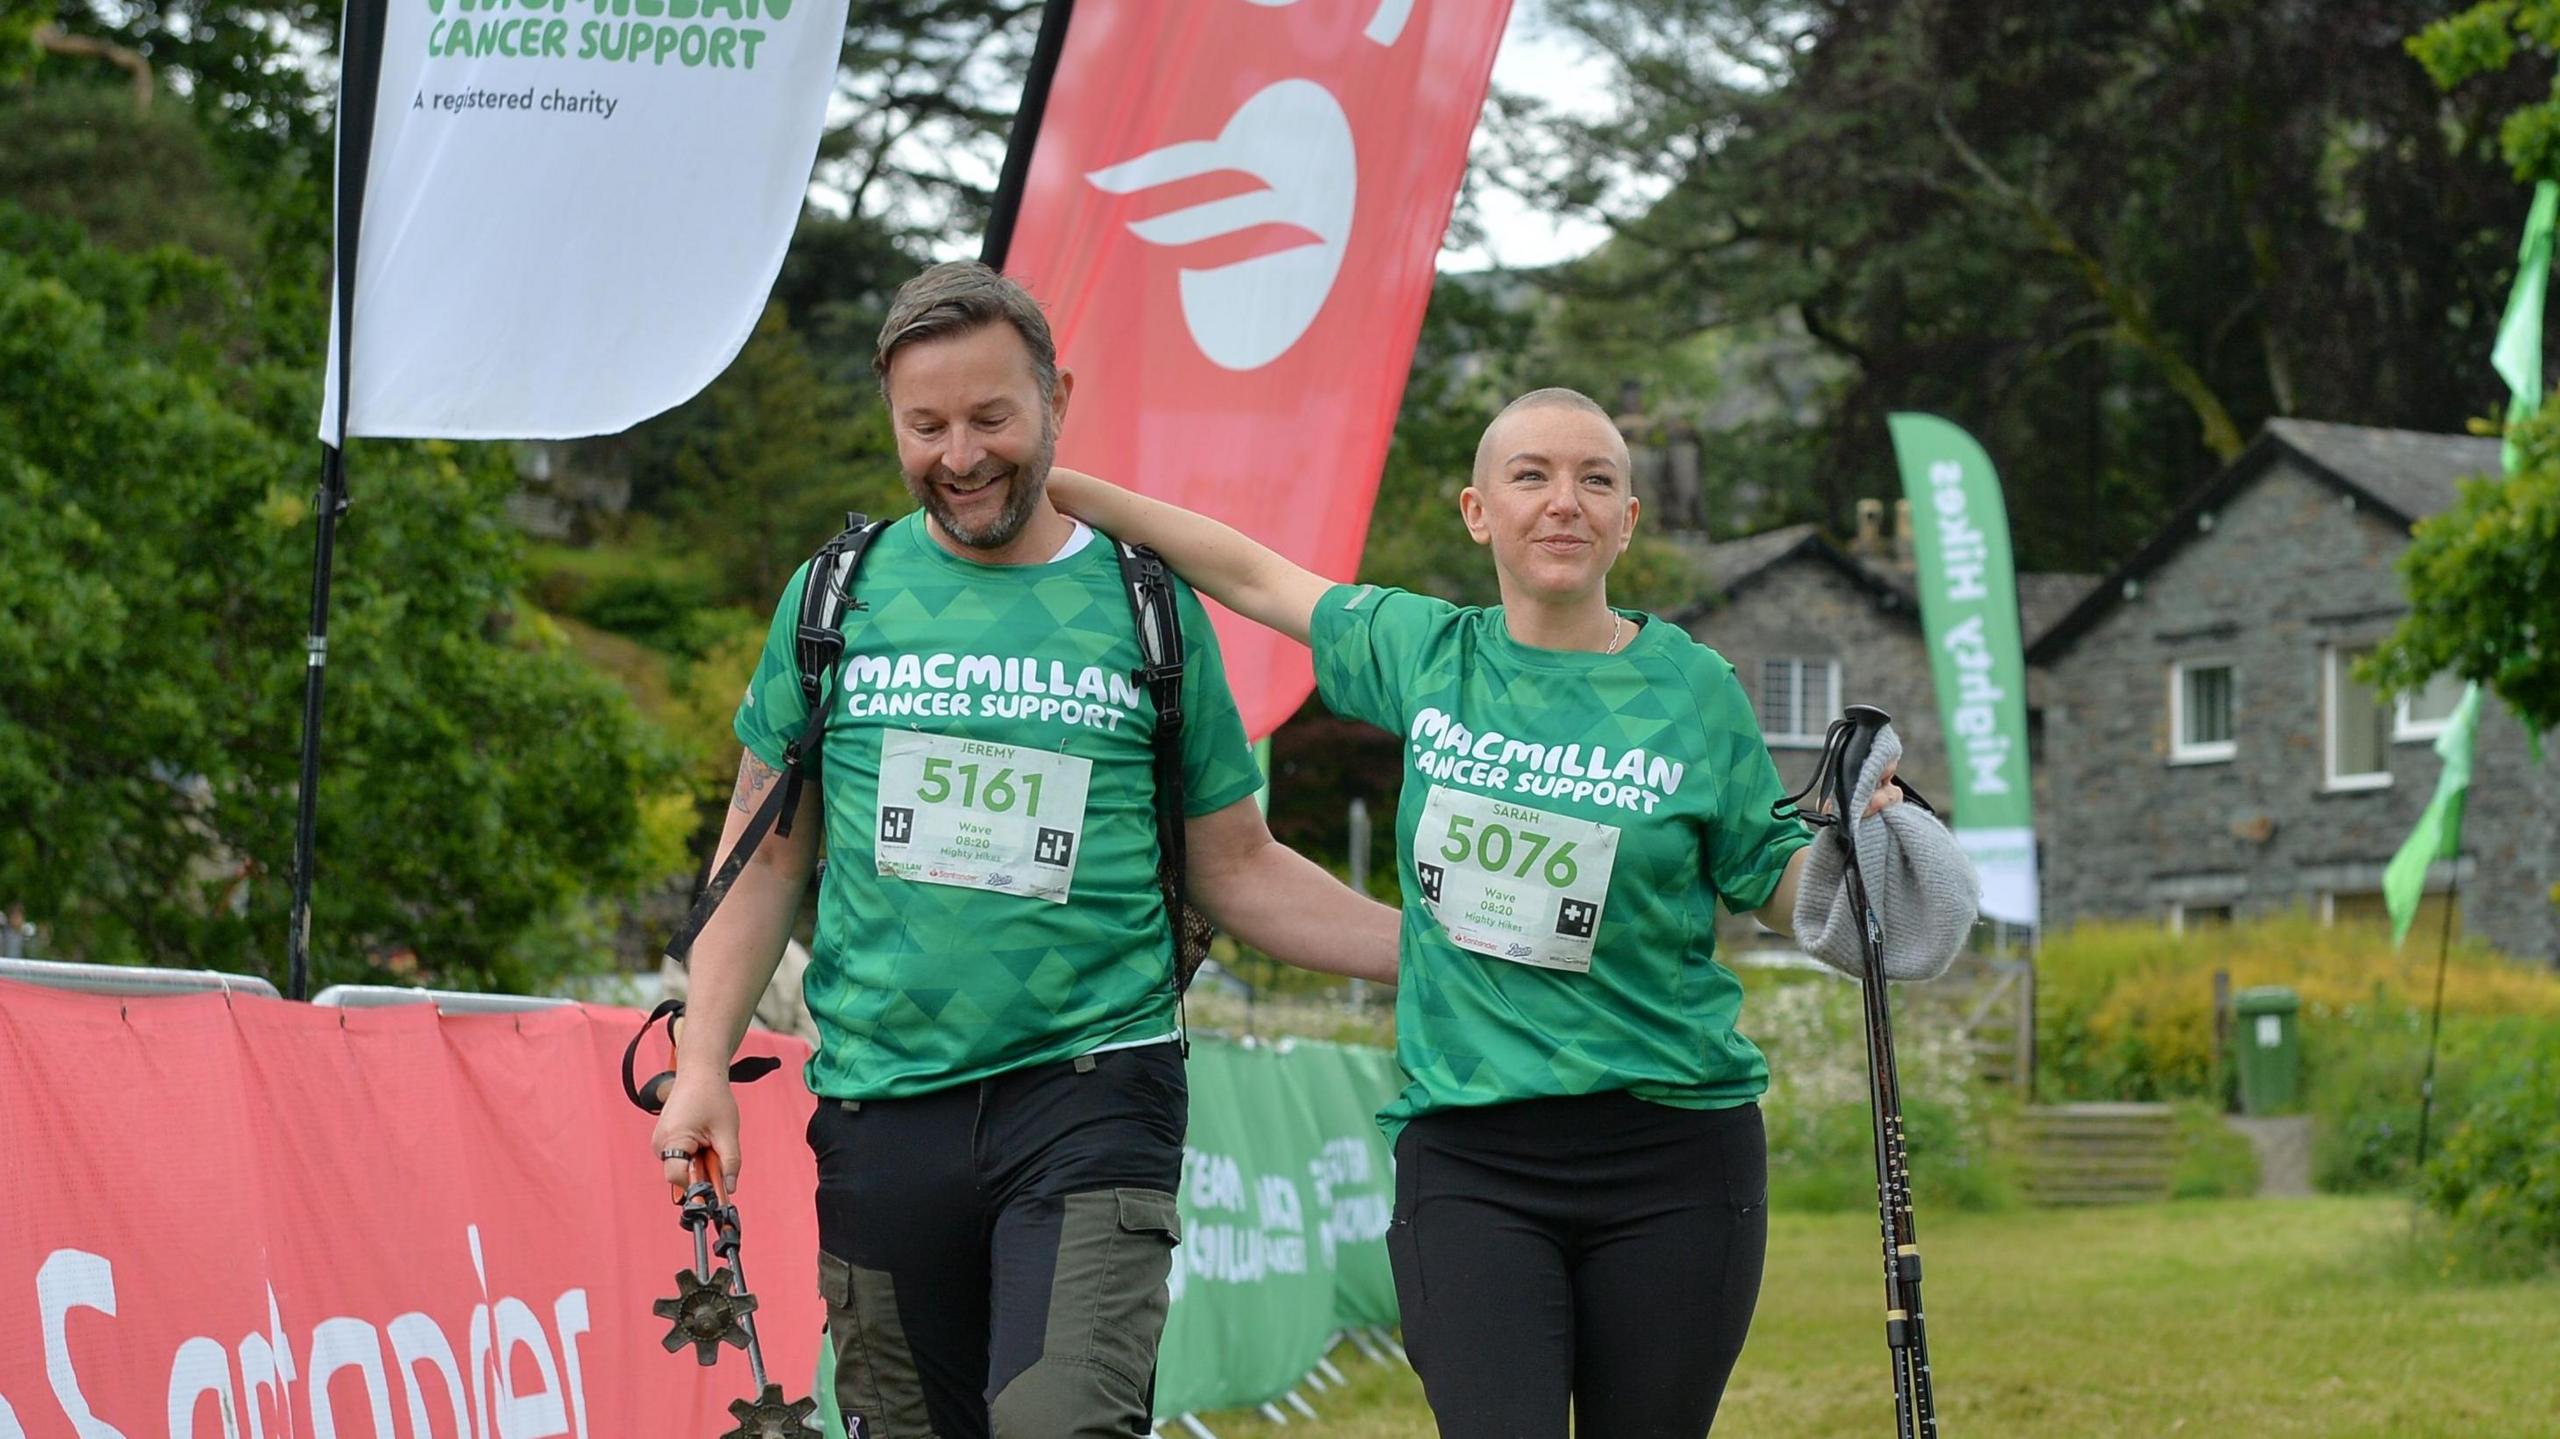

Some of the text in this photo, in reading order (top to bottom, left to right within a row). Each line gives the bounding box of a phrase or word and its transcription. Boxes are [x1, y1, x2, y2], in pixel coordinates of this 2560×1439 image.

[429, 18, 766, 69] CANCER SUPPORT
[413, 87, 618, 119] A registered charity
[844, 653, 1140, 710] MACMILLAN
[848, 692, 1125, 732] CANCER SUPPORT
[960, 742, 1016, 760] JEREMY
[1411, 707, 1684, 795] MACMILLAN
[916, 757, 1043, 818] 5161
[1513, 771, 1661, 815] SUPPORT
[959, 822, 992, 836] Wave
[1493, 803, 1540, 824] SARAH
[955, 835, 990, 849] 08:20
[1440, 814, 1578, 888] 5076
[1480, 900, 1513, 917] 08:20
[1485, 887, 1516, 903] Wave
[1465, 912, 1522, 933] Mighty Hikes
